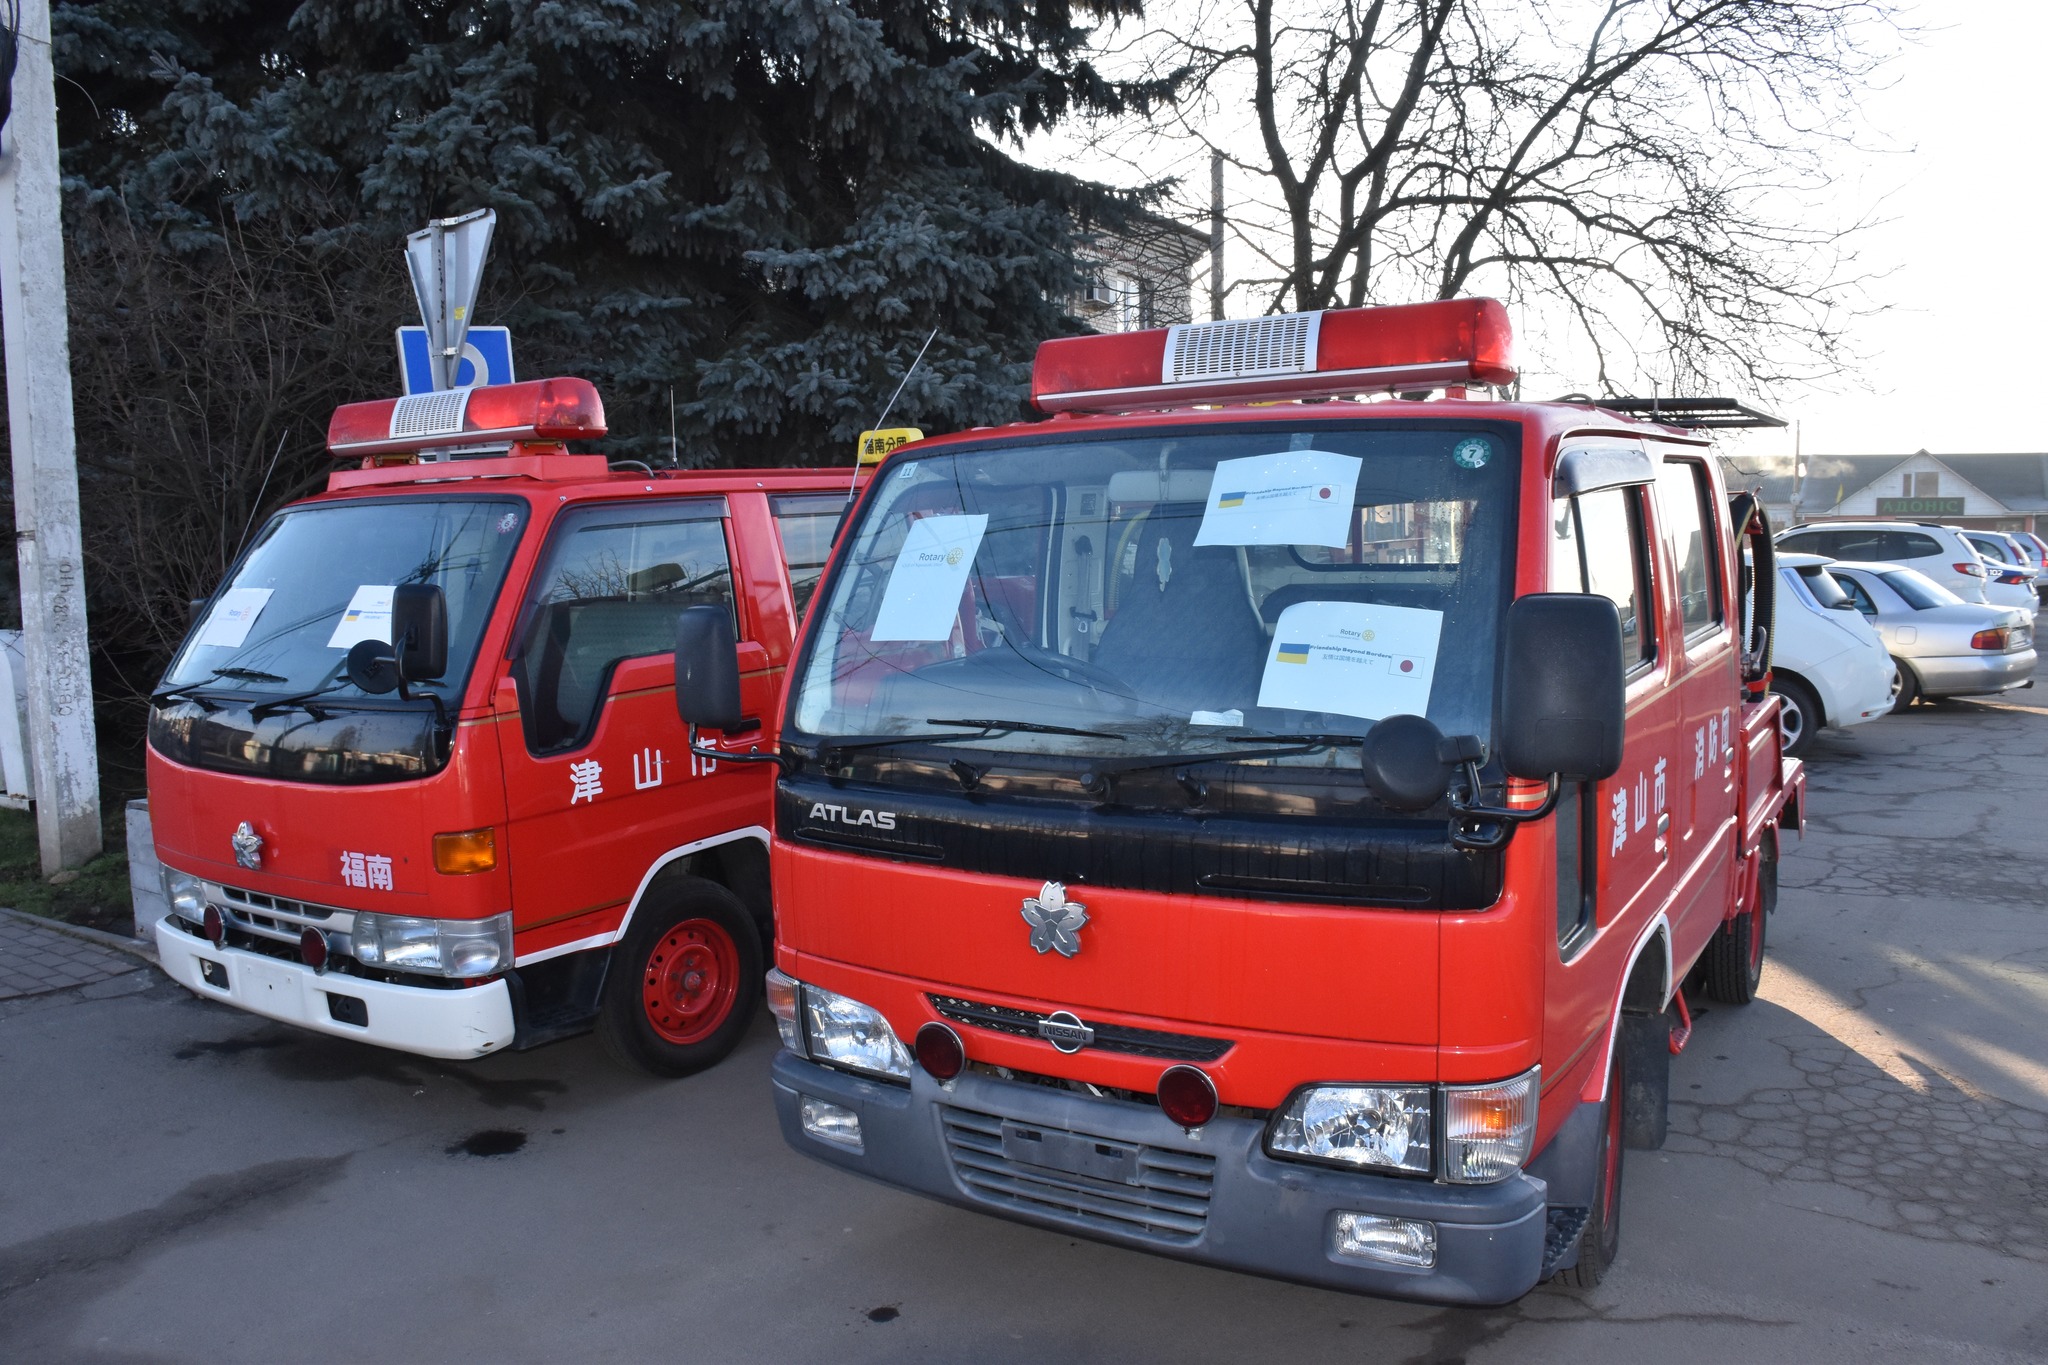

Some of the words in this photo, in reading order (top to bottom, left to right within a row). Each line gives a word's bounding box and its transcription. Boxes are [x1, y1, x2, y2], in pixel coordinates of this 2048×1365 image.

[1469, 449, 1477, 459] 7
[919, 552, 946, 562] Rotary
[1340, 628, 1361, 637] Rotary
[570, 736, 717, 804] 津山市
[809, 802, 896, 830] ATLAS
[1612, 756, 1667, 858] 津山市
[340, 850, 394, 891] 福南
[1044, 1025, 1087, 1040] NISSAN
